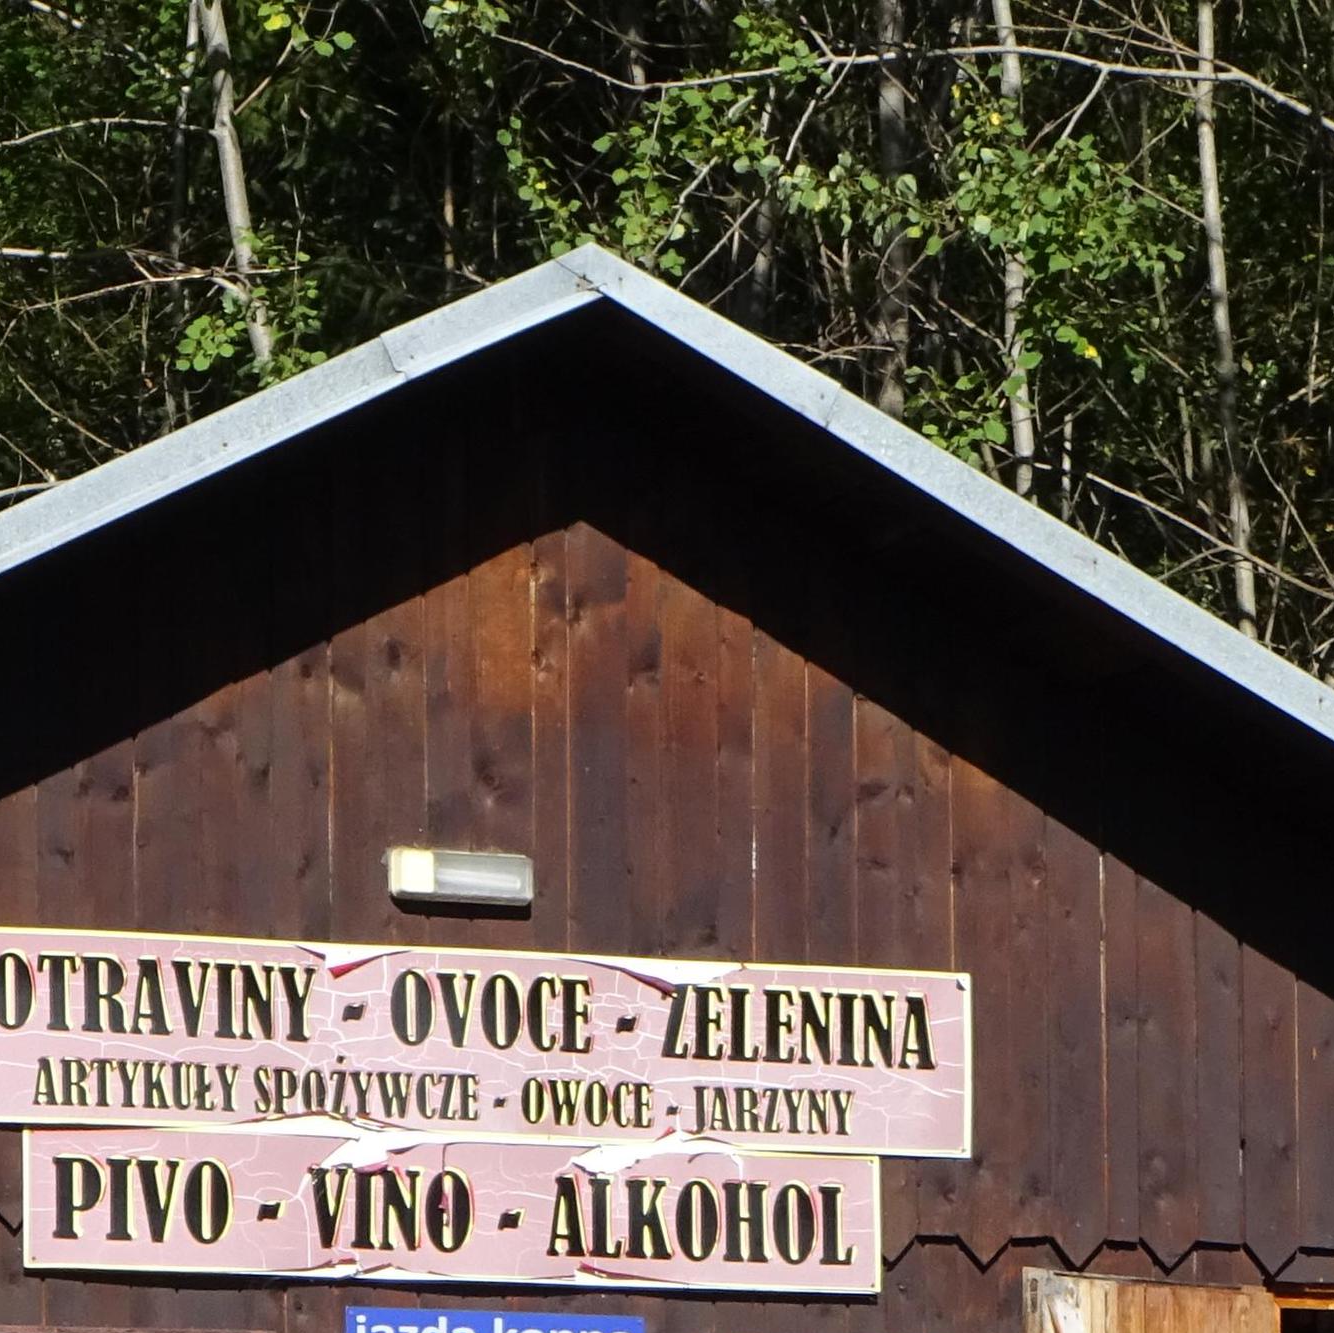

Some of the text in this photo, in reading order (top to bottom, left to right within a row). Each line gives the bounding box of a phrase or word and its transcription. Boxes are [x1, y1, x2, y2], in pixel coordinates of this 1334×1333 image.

[389, 968, 594, 1054] OVOCE
[661, 982, 938, 1071] ZELENINA
[33, 1056, 241, 1112] ARTYKUŁY
[254, 1055, 480, 1121] SPOŻYWCZE
[520, 1076, 655, 1129] OWOCE
[692, 1085, 856, 1136] JARZYNY
[52, 1153, 233, 1244] PIVO
[545, 1173, 858, 1266] ALKOHOL
